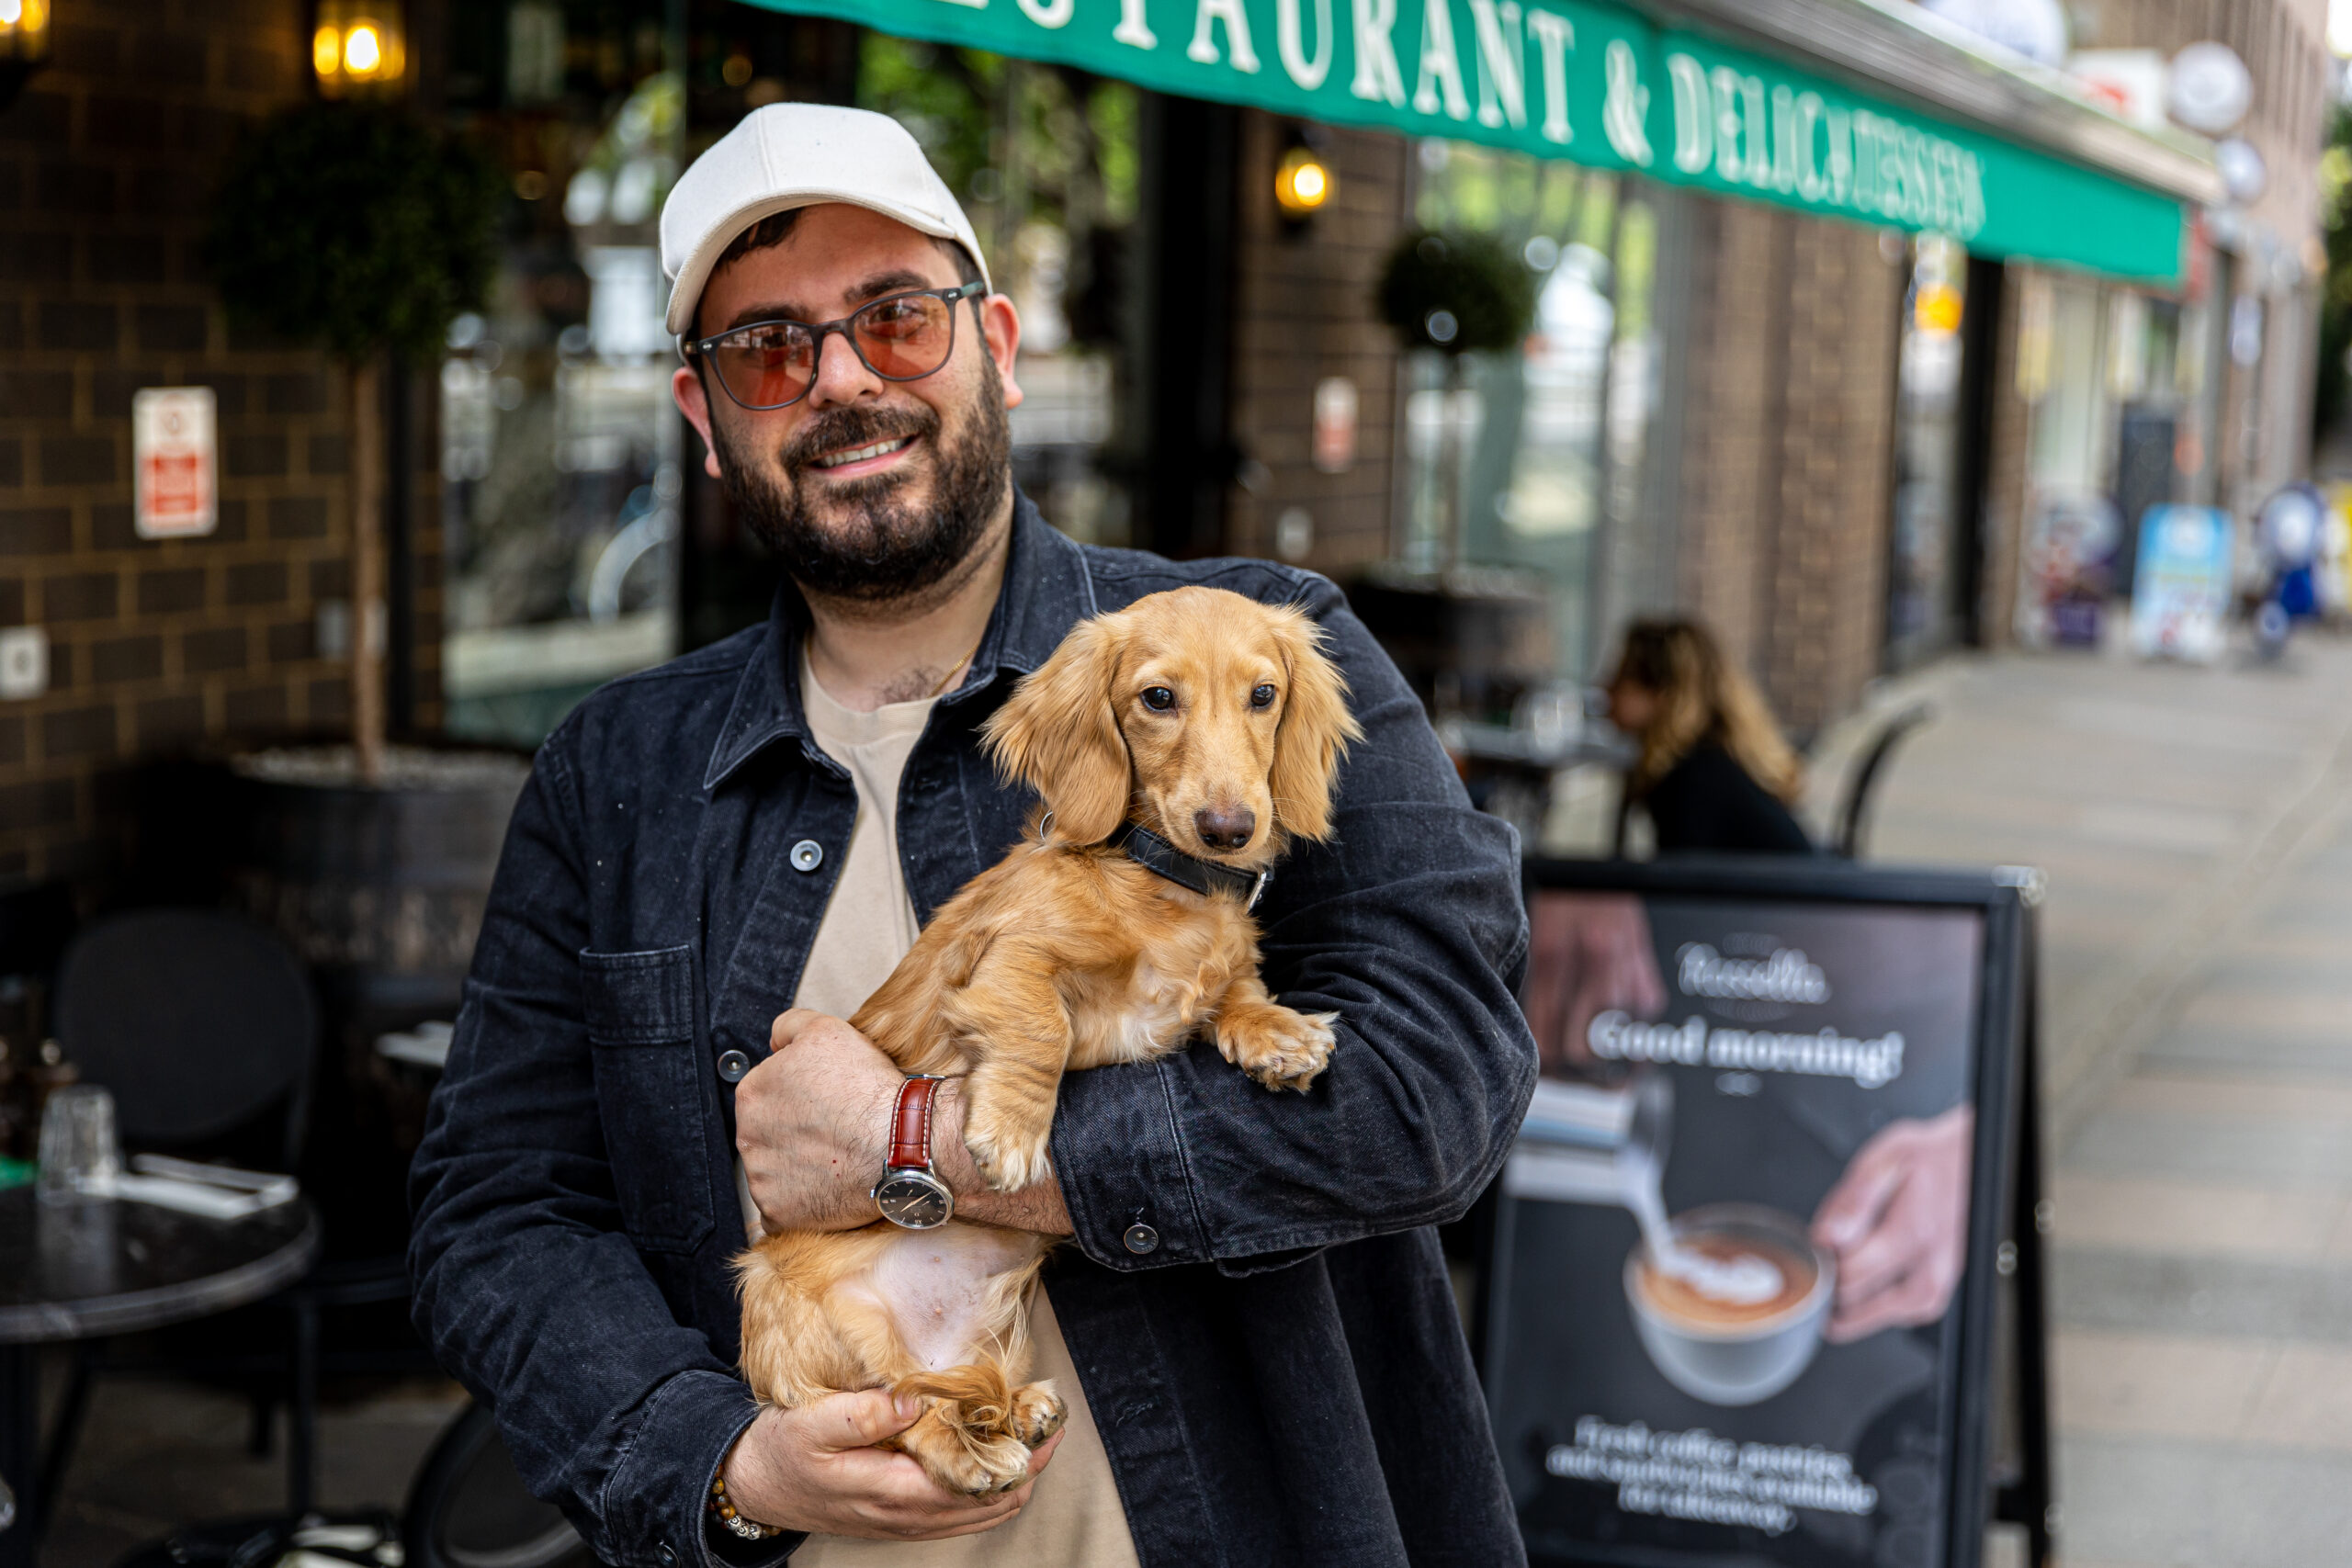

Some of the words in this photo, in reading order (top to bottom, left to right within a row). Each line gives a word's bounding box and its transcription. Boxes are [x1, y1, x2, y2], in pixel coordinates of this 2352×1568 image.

[1602, 39, 1653, 167] &
[1667, 53, 1985, 241] DELICATESSEN
[1588, 1011, 1707, 1066] Good
[1707, 1027, 1905, 1089] morning!
